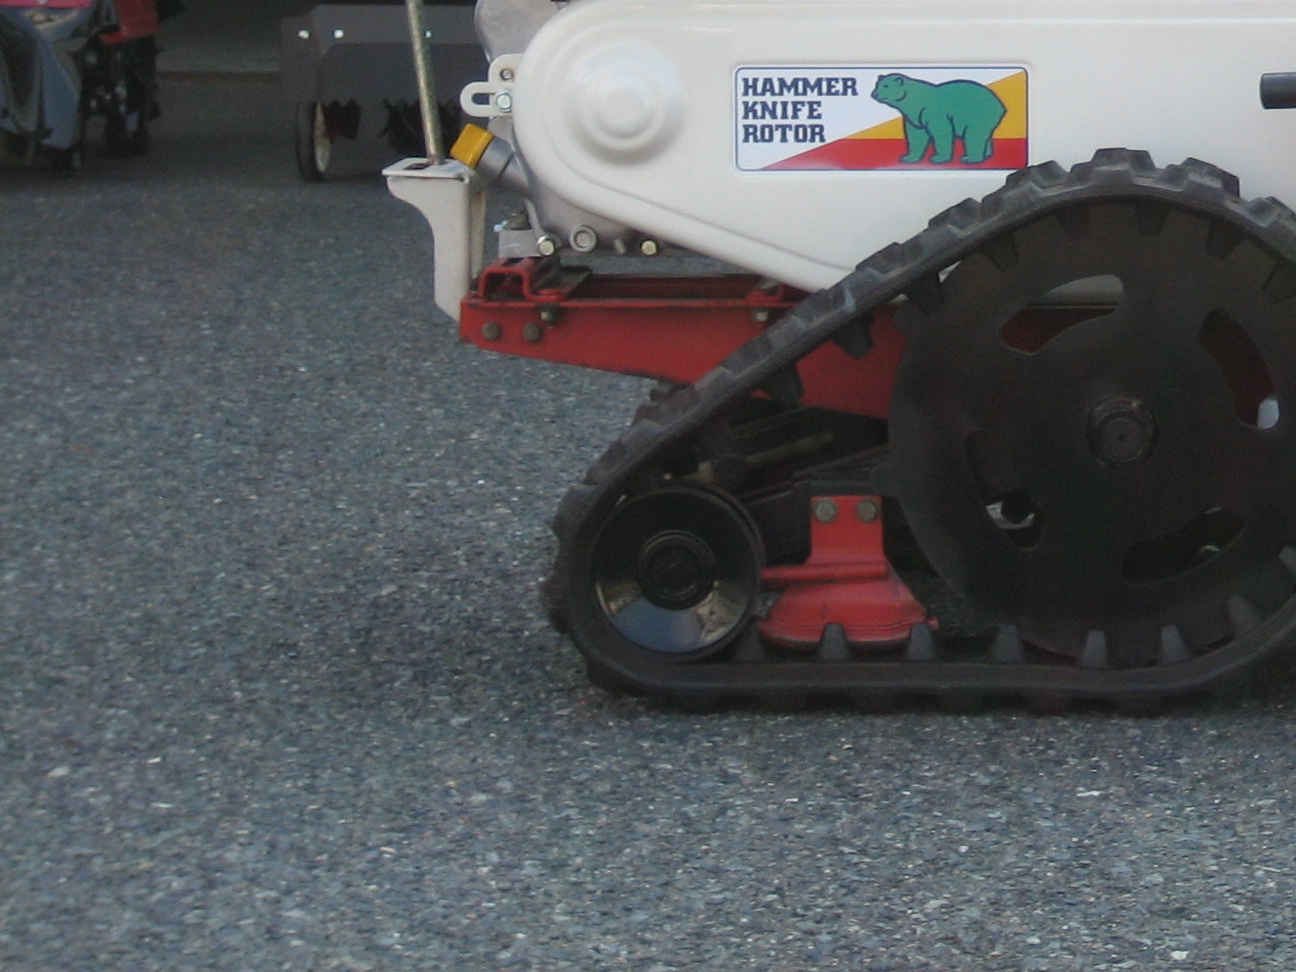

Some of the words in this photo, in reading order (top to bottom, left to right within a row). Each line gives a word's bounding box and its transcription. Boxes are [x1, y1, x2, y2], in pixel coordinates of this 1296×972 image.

[742, 77, 857, 96] HAMMER
[742, 101, 822, 119] KNIFE
[742, 124, 825, 142] ROTOR
